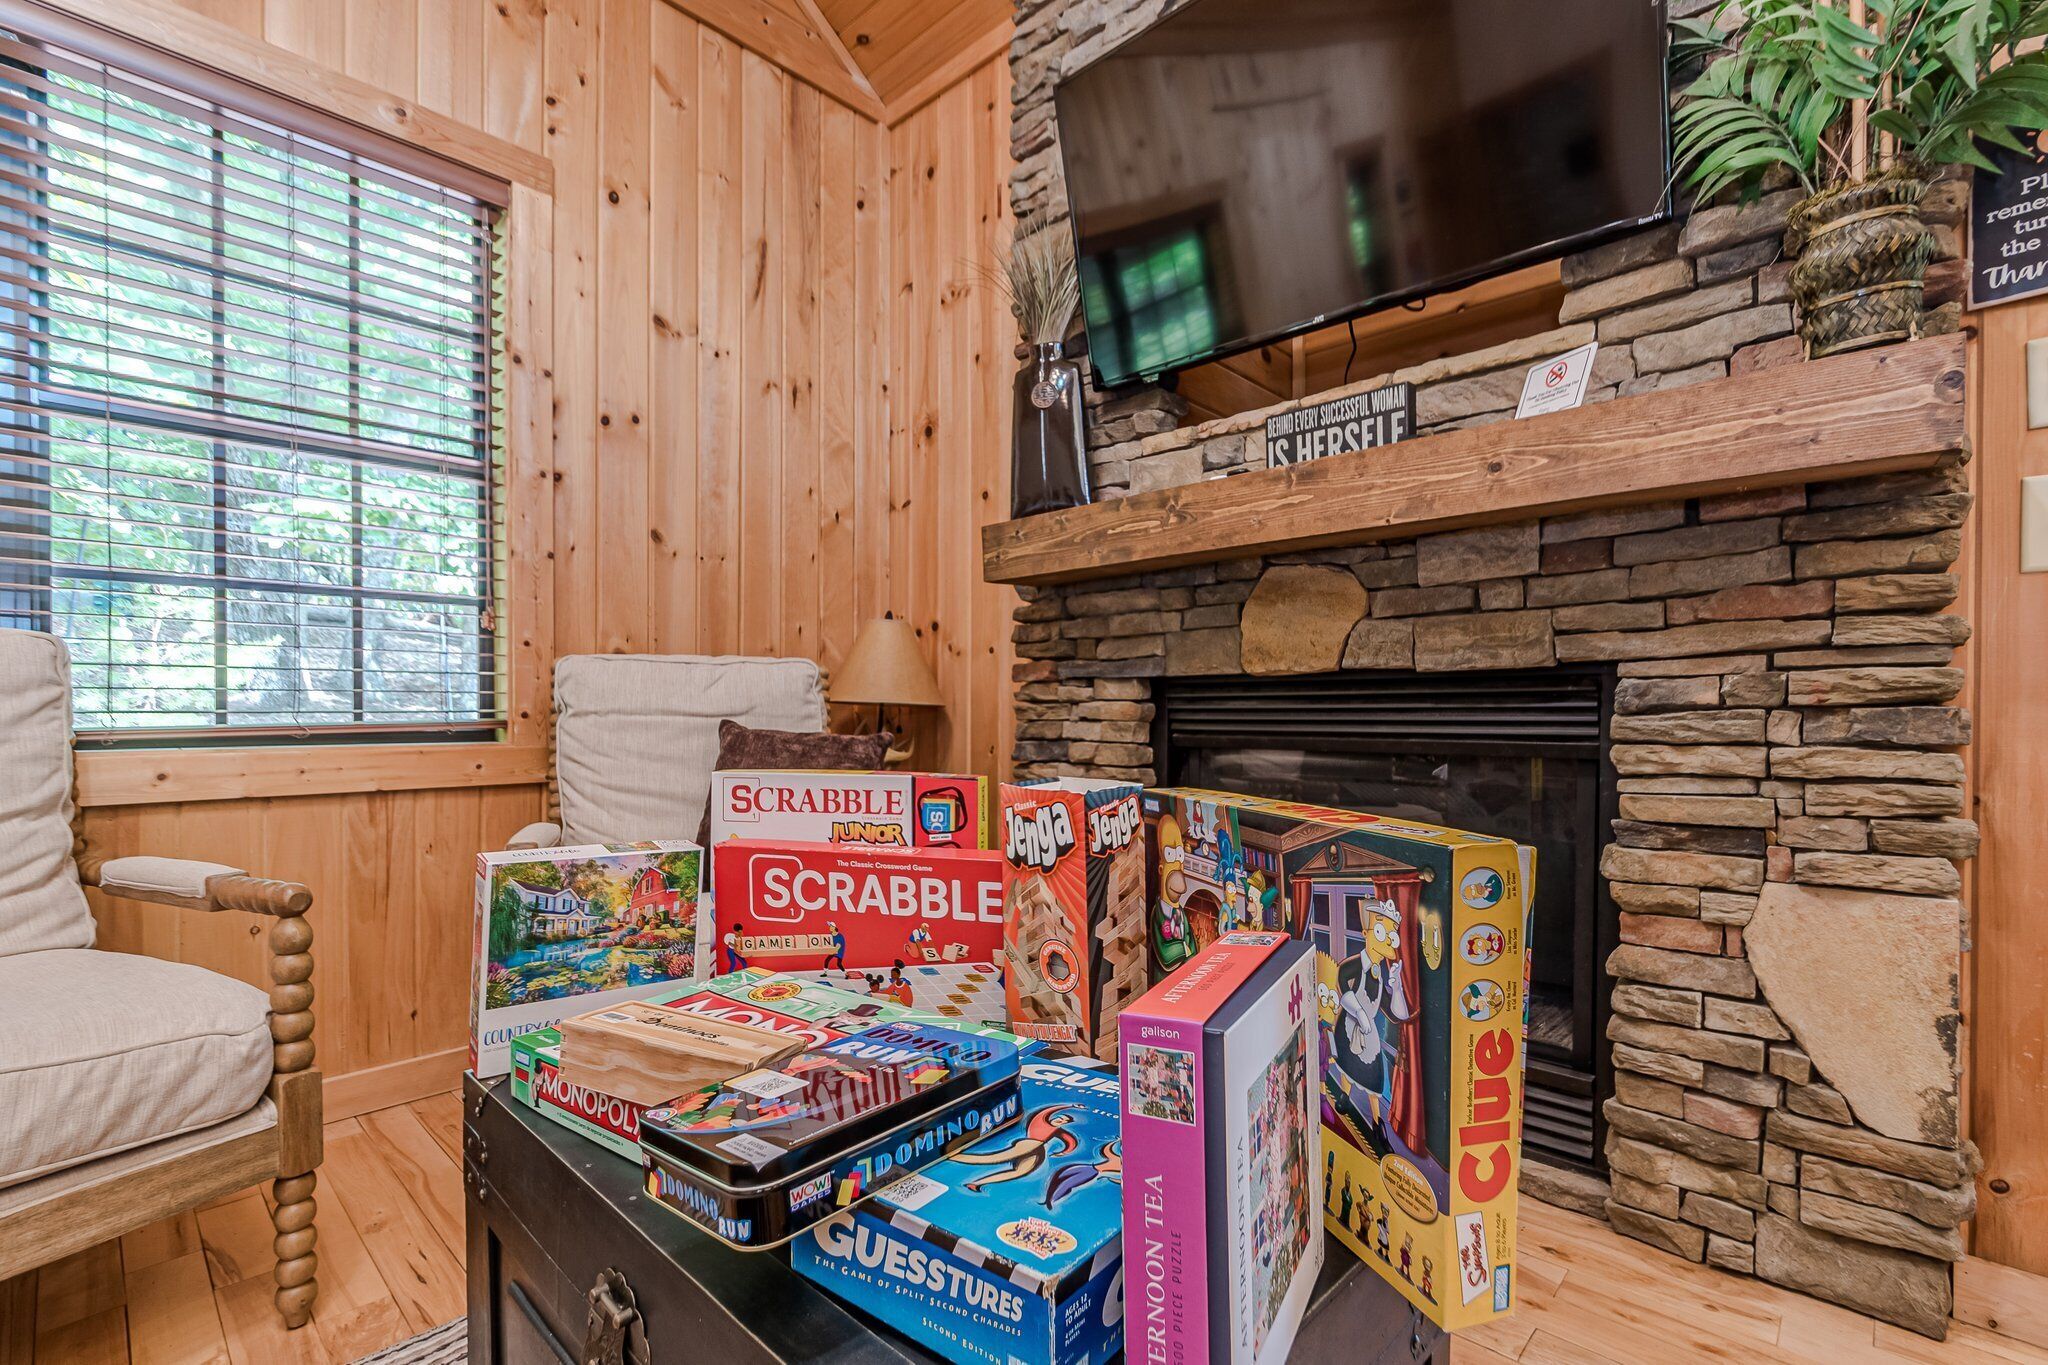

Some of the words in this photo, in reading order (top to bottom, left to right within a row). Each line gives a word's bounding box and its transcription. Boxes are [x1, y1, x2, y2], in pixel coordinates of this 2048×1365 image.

[1986, 196, 2048, 224] reme
[2000, 238, 2041, 257] the
[1267, 414, 1294, 439] BEHIND
[1295, 406, 1319, 432] EVERY
[1320, 394, 1370, 426] SUCCESSFUL
[1371, 385, 1406, 413] WOMAN
[1267, 438, 1290, 469] IS
[1296, 410, 1406, 463] HERSELF
[731, 784, 905, 816] SCRABBLE
[1014, 800, 1037, 811] Classic
[1100, 799, 1120, 813] Classic
[828, 821, 908, 847] JUNIOR
[1005, 802, 1075, 867] Jenga
[1090, 797, 1139, 852] Jenga
[837, 859, 849, 867] The
[875, 862, 911, 871] Crossword
[764, 867, 1003, 924] SCRABBLE
[744, 938, 791, 949] GAME
[811, 937, 831, 946] ON
[1043, 944, 1067, 956] GENUINE
[1047, 973, 1077, 991] HARDWOOD
[1161, 963, 1213, 1003] AFTERNOON
[1208, 952, 1232, 966] TEA
[636, 1017, 720, 1039] Dominoes
[1141, 1026, 1180, 1040] galison
[824, 1041, 923, 1064] RUN
[1458, 1027, 1514, 1204] Clue
[875, 1110, 980, 1178] DOMINO
[980, 1095, 1017, 1136] RUN
[1235, 1136, 1244, 1189] TEA
[667, 1173, 719, 1221] DOMINO
[790, 1174, 831, 1204] WOW!
[790, 1188, 832, 1212] GAMES
[1144, 1174, 1164, 1229] TEA
[718, 1217, 751, 1241] RUN
[814, 1212, 1023, 1322] GUESSTURES
[1170, 1231, 1182, 1284] PUZZLE
[1238, 1194, 1248, 1348] AFTERNOON
[815, 1256, 835, 1270] THE
[841, 1266, 872, 1283] GAME
[878, 1279, 890, 1290] OF
[895, 1285, 925, 1301] SPLIT
[930, 1297, 968, 1317] SECOND
[973, 1313, 1022, 1337] CHARADES
[1065, 1299, 1081, 1318] AGES
[1081, 1293, 1088, 1303] 12
[1065, 1316, 1073, 1327] TO
[1074, 1298, 1091, 1323] ADULT
[1145, 1238, 1166, 1365] ERNOON
[1172, 1291, 1183, 1334] PIECE
[922, 1317, 957, 1341] SECOND
[962, 1339, 1001, 1365] EDITION
